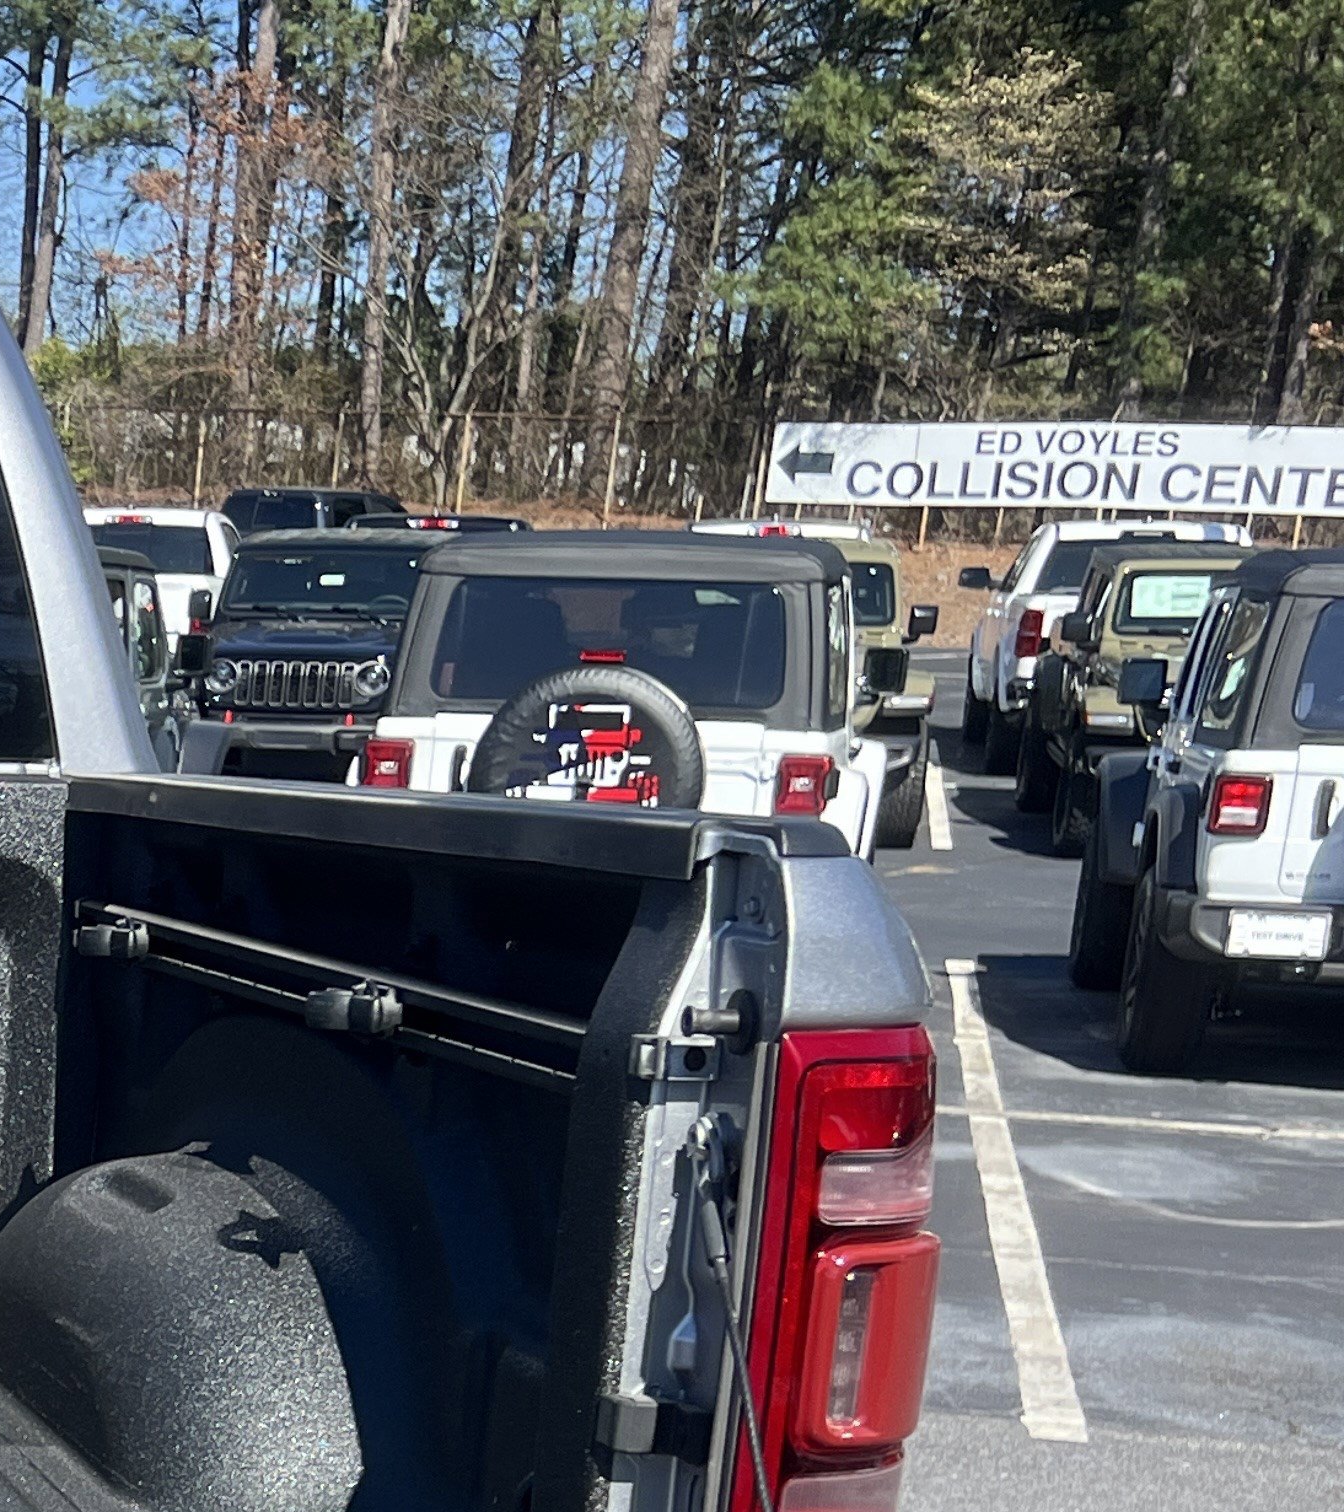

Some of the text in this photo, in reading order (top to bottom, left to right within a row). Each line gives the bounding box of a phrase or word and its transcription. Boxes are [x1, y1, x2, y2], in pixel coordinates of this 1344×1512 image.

[975, 430, 1180, 457] ED VOYLES
[846, 460, 1141, 501] COLLISION
